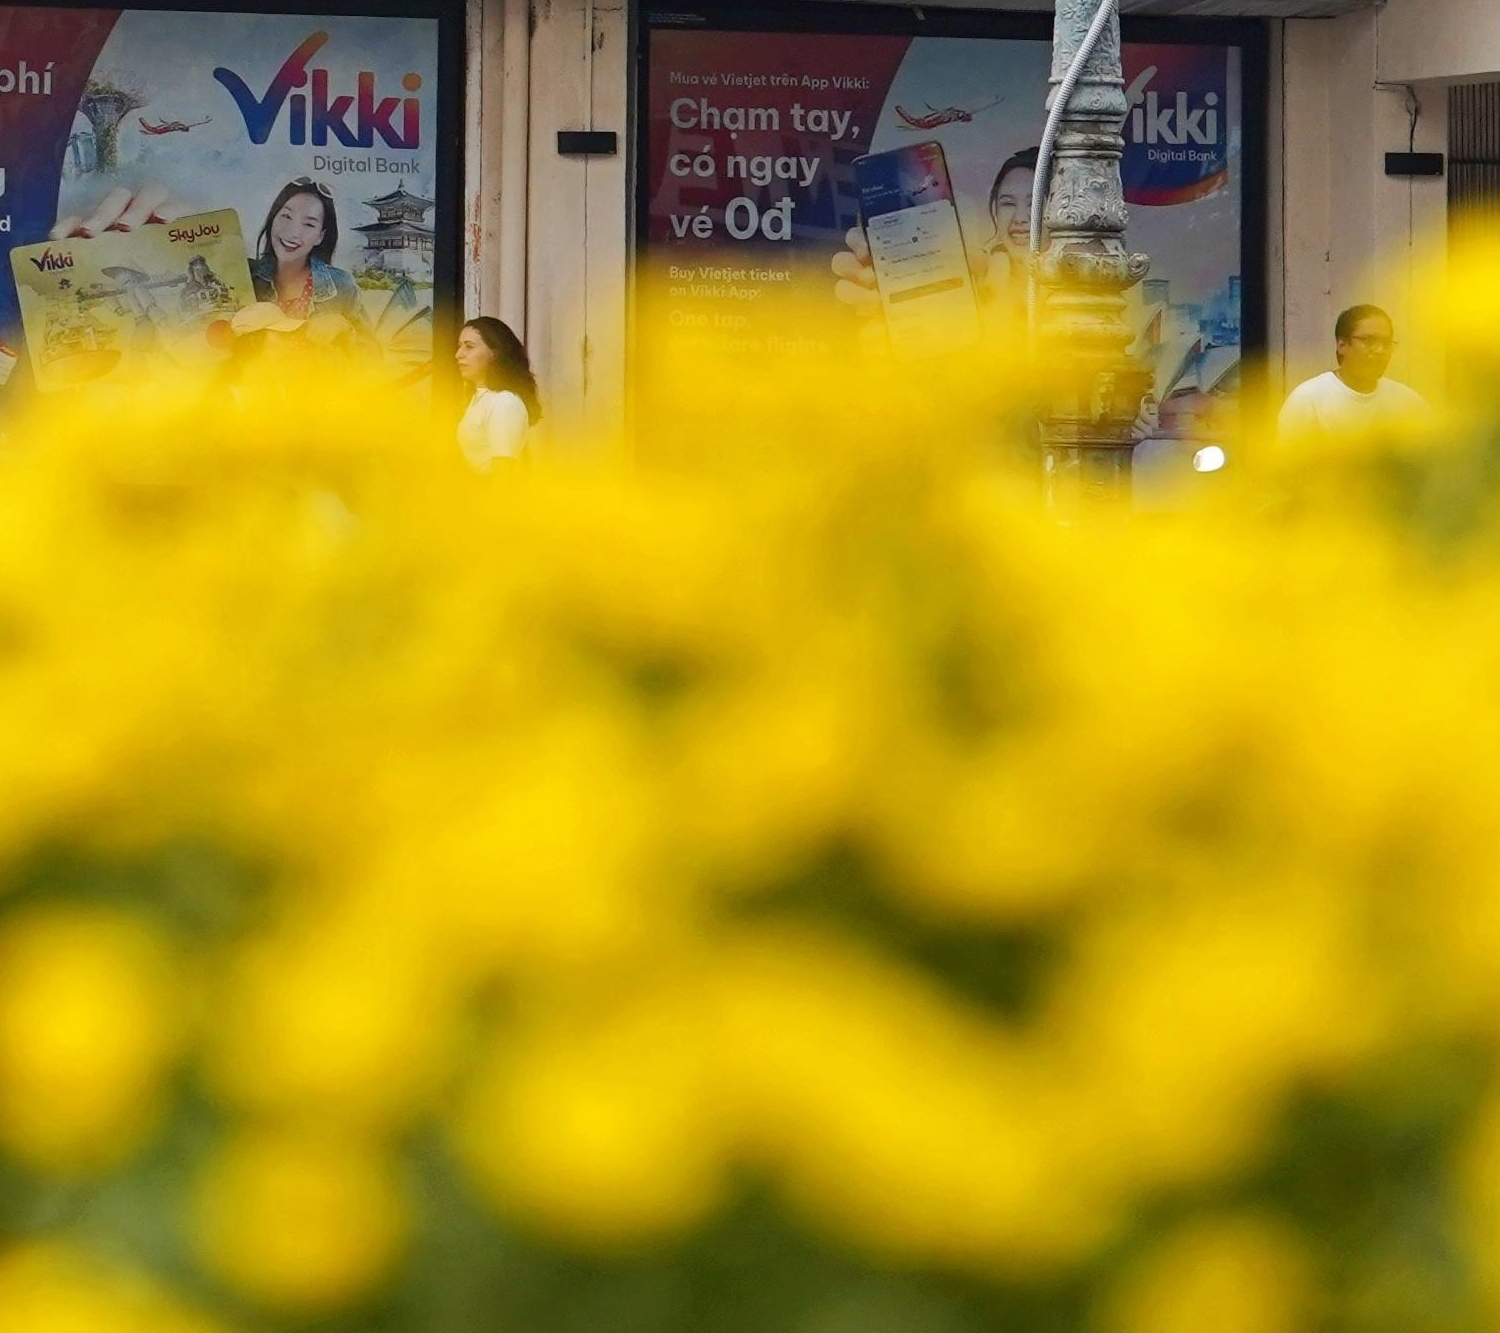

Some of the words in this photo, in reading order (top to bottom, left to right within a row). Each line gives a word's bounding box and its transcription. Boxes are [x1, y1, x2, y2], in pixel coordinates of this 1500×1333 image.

[213, 30, 423, 150] Vikki
[669, 71, 700, 85] Mua
[721, 72, 766, 89] Vietjet
[770, 73, 798, 87] trên
[801, 74, 828, 90] App
[669, 97, 780, 141] Chạm
[790, 102, 861, 141] tay,
[313, 155, 371, 175] Digital
[375, 157, 421, 174] Bank
[669, 144, 716, 178] có
[726, 155, 821, 187] ngay
[1148, 149, 1186, 164] Digital
[1188, 150, 1218, 162] Bank
[670, 204, 714, 239] vé
[724, 195, 796, 241] 0đ
[29, 246, 74, 272] Vikki
[669, 265, 696, 281] Buy
[699, 266, 747, 283] Vietjet
[749, 268, 791, 282] ticket
